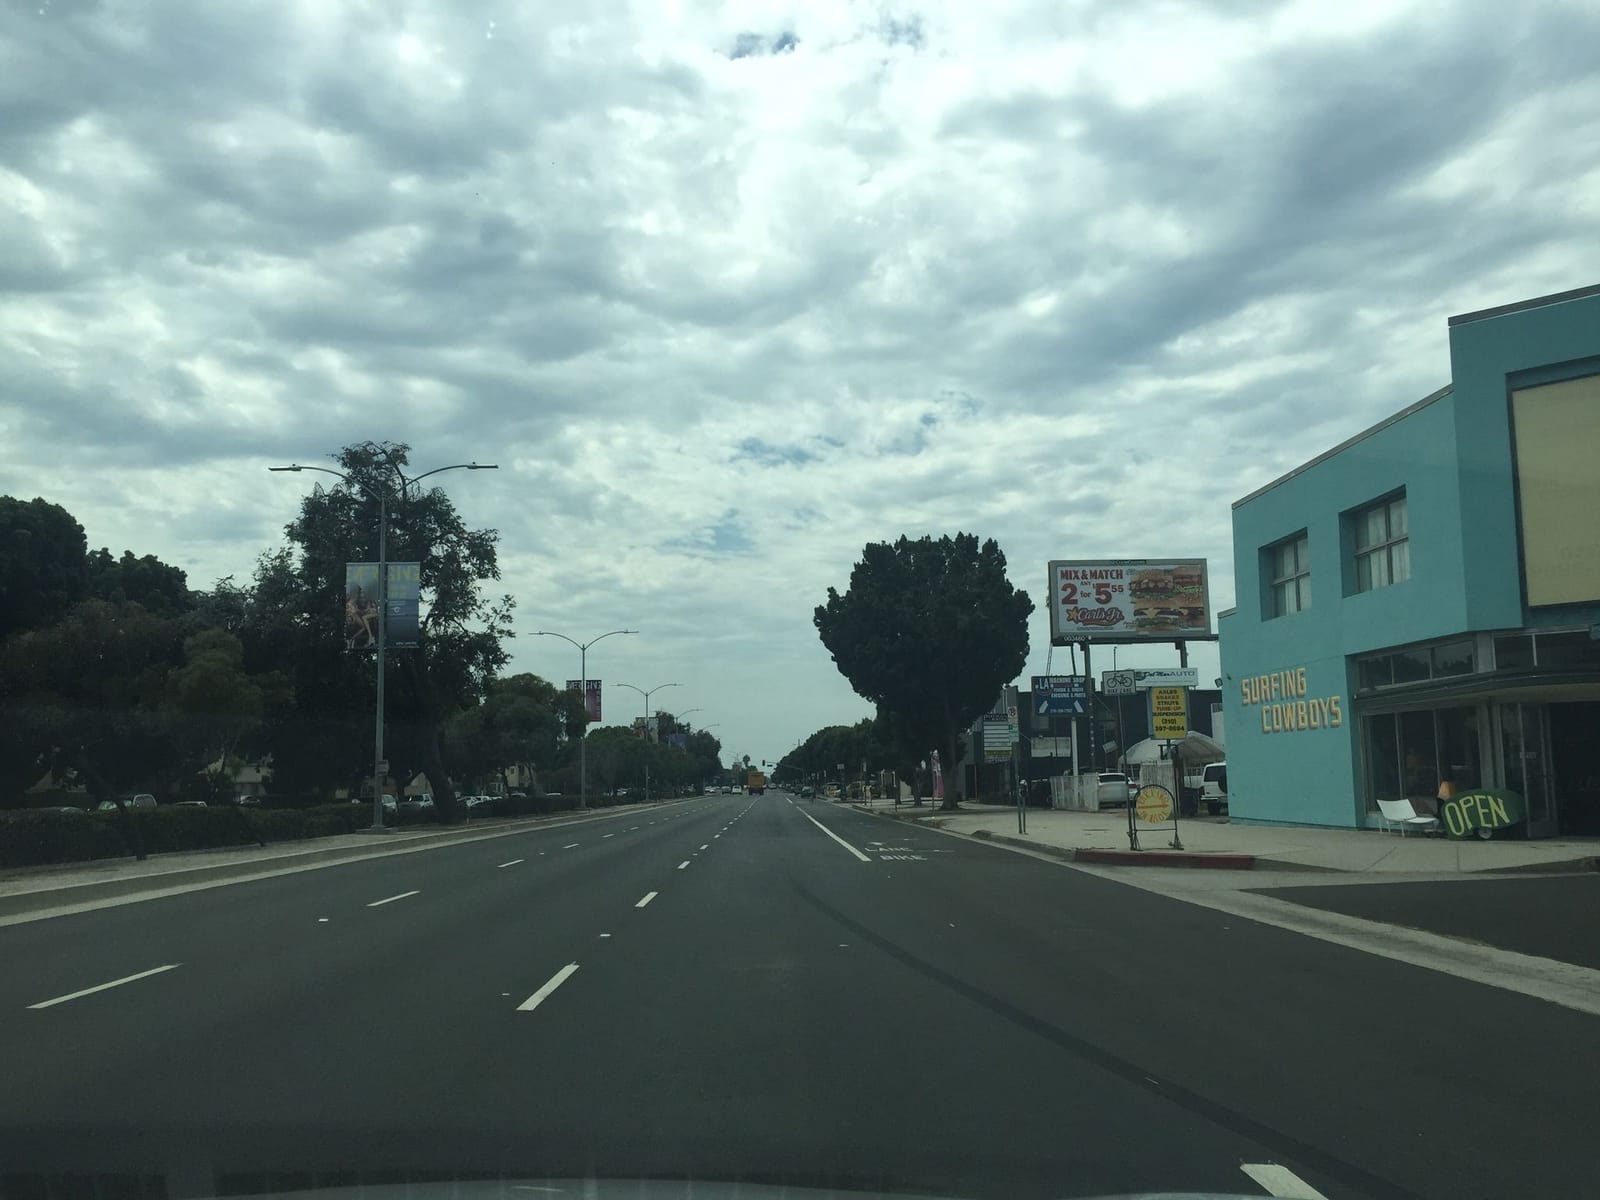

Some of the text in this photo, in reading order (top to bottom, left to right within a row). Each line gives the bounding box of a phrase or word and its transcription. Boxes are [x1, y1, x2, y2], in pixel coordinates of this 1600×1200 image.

[1060, 569, 1079, 580] MIX
[1081, 569, 1089, 580] &
[1090, 569, 1123, 580] MATCH
[1061, 583, 1078, 605] 2
[1240, 668, 1307, 705] SURFING
[1261, 695, 1342, 733] COWBOYS
[1444, 794, 1510, 837] OPEN
